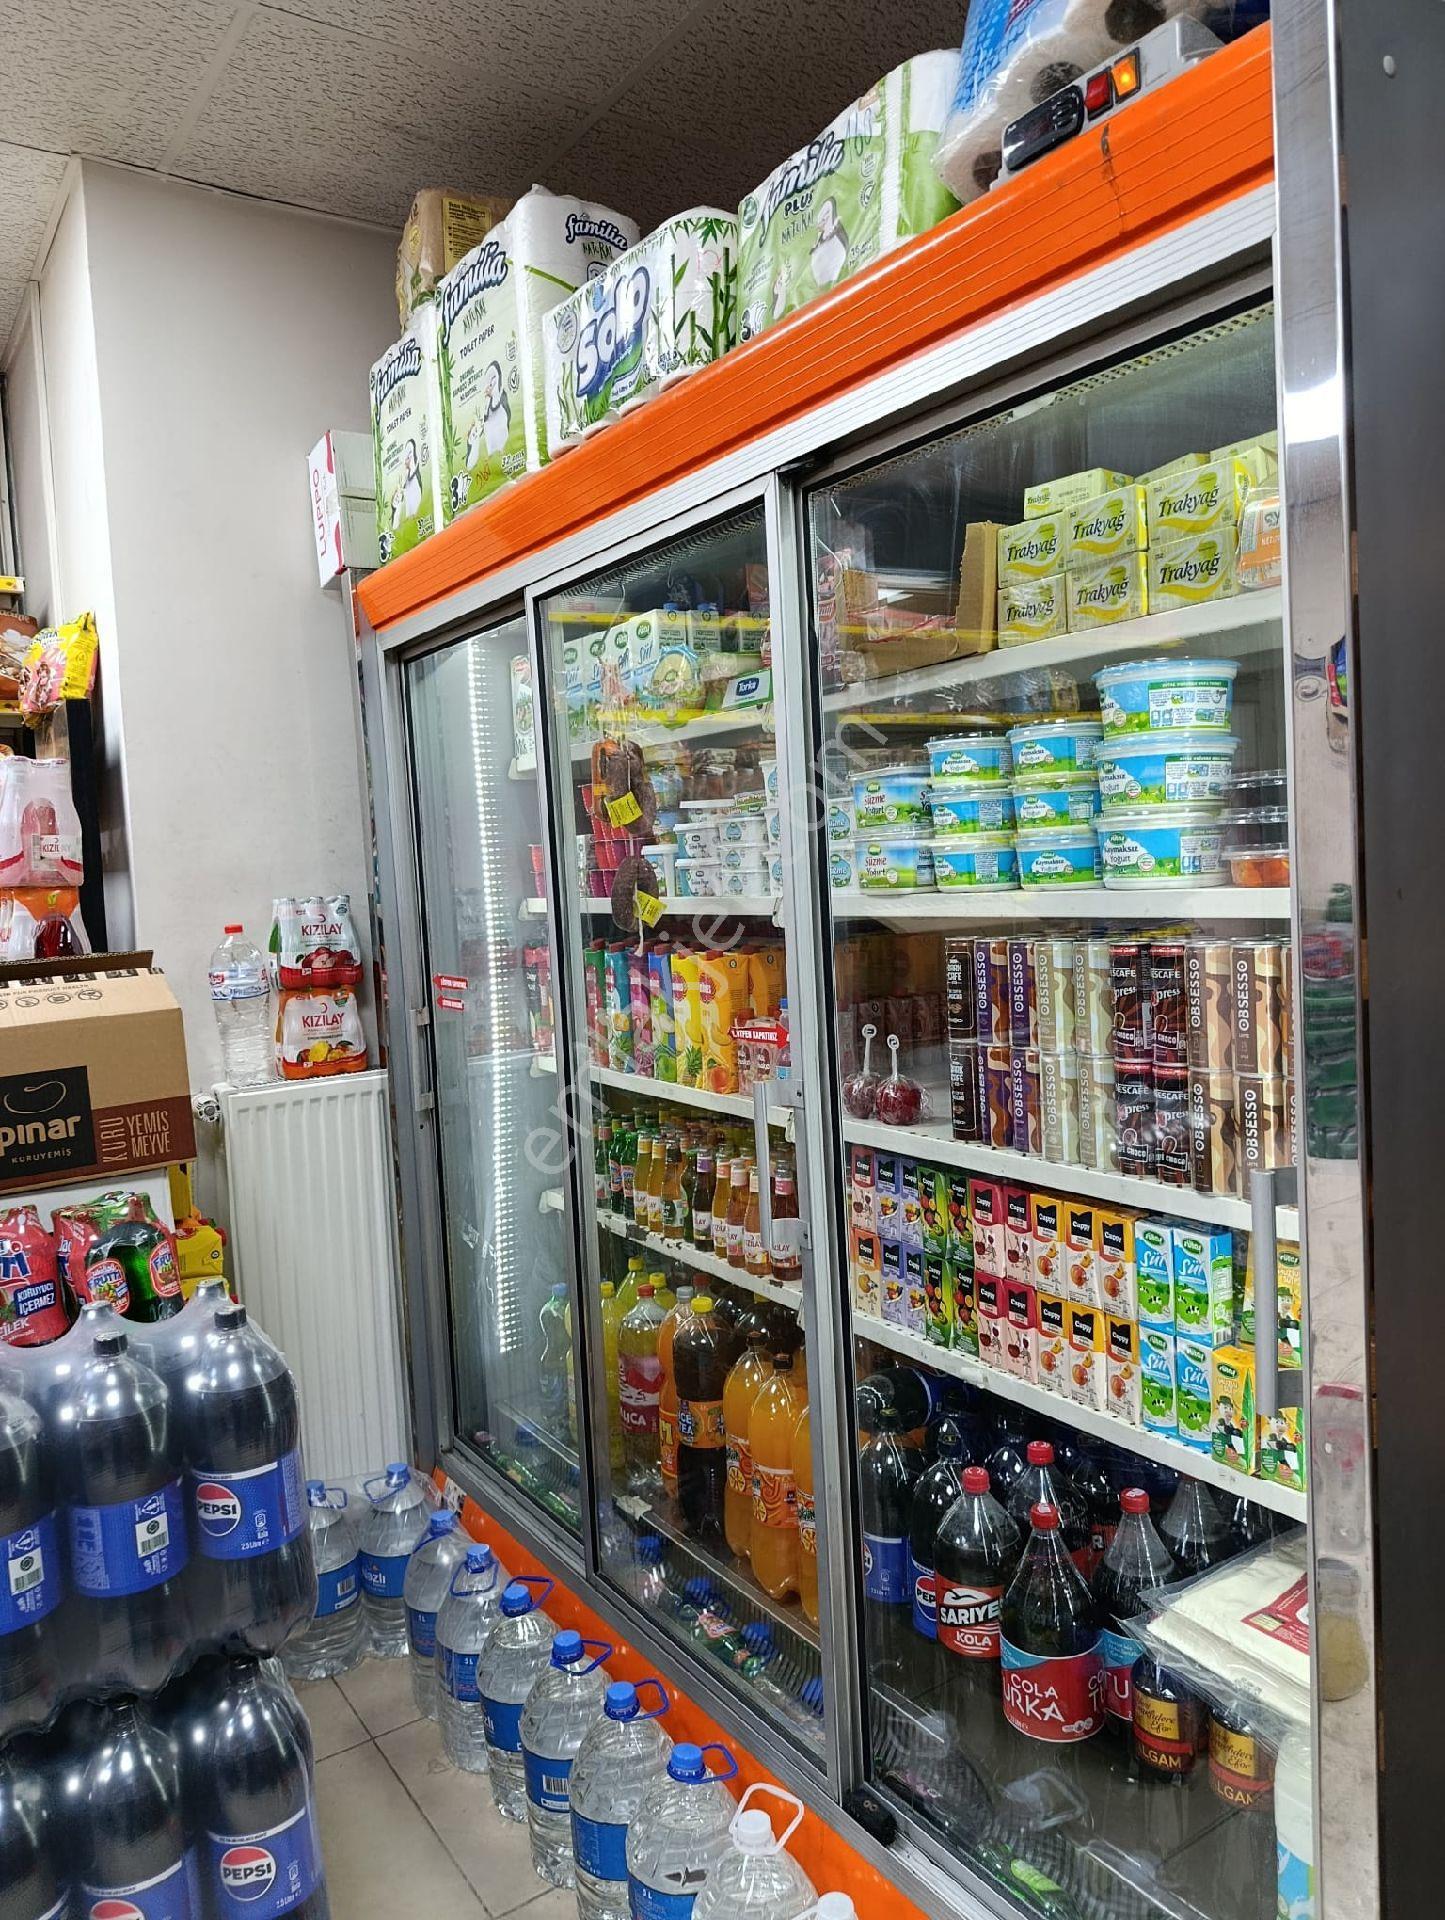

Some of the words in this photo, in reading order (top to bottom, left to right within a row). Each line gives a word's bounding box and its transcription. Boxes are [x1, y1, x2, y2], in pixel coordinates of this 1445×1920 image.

[566, 213, 628, 250] familia
[459, 337, 477, 360] TOILET
[478, 324, 495, 346] PAPER
[1158, 486, 1220, 518] Trakyağ
[312, 468, 328, 558] LUPPO
[1072, 511, 1125, 541] Trakyağ
[1007, 535, 1057, 563] Trakyağ
[1160, 553, 1221, 585] Trakyağ
[1076, 578, 1129, 607] Trakyağ
[1006, 596, 1055, 623] Trakyağ
[865, 793, 885, 805] Süzme
[865, 856, 887, 867] Süzme
[301, 923, 343, 937] KIZILAY
[976, 951, 987, 1009] OBSESSO
[1013, 952, 1023, 1012] OBSESSO
[1039, 954, 1050, 1016] OBSESSO
[1075, 954, 1086, 1017] OBSESSO
[1189, 958, 1201, 1028] OBSESSO
[1237, 959, 1249, 1032] OBSESSO
[302, 1013, 345, 1028] KIZILAY
[1013, 1059, 1024, 1117] OBSESSO
[1046, 1062, 1057, 1126] OBSESSO
[1080, 1068, 1090, 1130] OBSESSO
[1193, 1083, 1204, 1152] OBSESSO
[1245, 1089, 1259, 1160] OBSESSO
[98, 1116, 128, 1163] KURU
[131, 1131, 171, 1158] MEYVE
[879, 1169, 893, 1178] Cappy
[922, 1177, 935, 1189] Cappy
[951, 1183, 967, 1194] Cappy
[976, 1196, 992, 1209] Cappy
[1009, 1203, 1026, 1214] Cappy
[1038, 1212, 1056, 1225] Cappy
[1072, 1220, 1090, 1233] Cappy
[1104, 1230, 1122, 1243] Cappy
[885, 1252, 898, 1262] Cappy
[1140, 1250, 1167, 1267] Süt
[928, 1265, 941, 1277] Cappy
[1178, 1258, 1205, 1276] Süt
[958, 1273, 973, 1284] Cappy
[17, 1282, 54, 1301] KORUYUCU
[980, 1288, 995, 1301] Cappy
[18, 1294, 55, 1316] İÇERMEZ
[1010, 1298, 1026, 1310] Cappy
[1043, 1308, 1061, 1321] Cappy
[1074, 1320, 1092, 1334] Cappy
[1112, 1331, 1129, 1343] Cappy
[1145, 1353, 1168, 1370] Süt
[1182, 1366, 1208, 1384] Süt
[199, 1503, 237, 1516] PEPSI
[956, 1630, 992, 1647] KOLA
[1010, 1673, 1058, 1700] COLA
[1002, 1682, 1065, 1722] URKA
[223, 1862, 272, 1880] PEPSI
